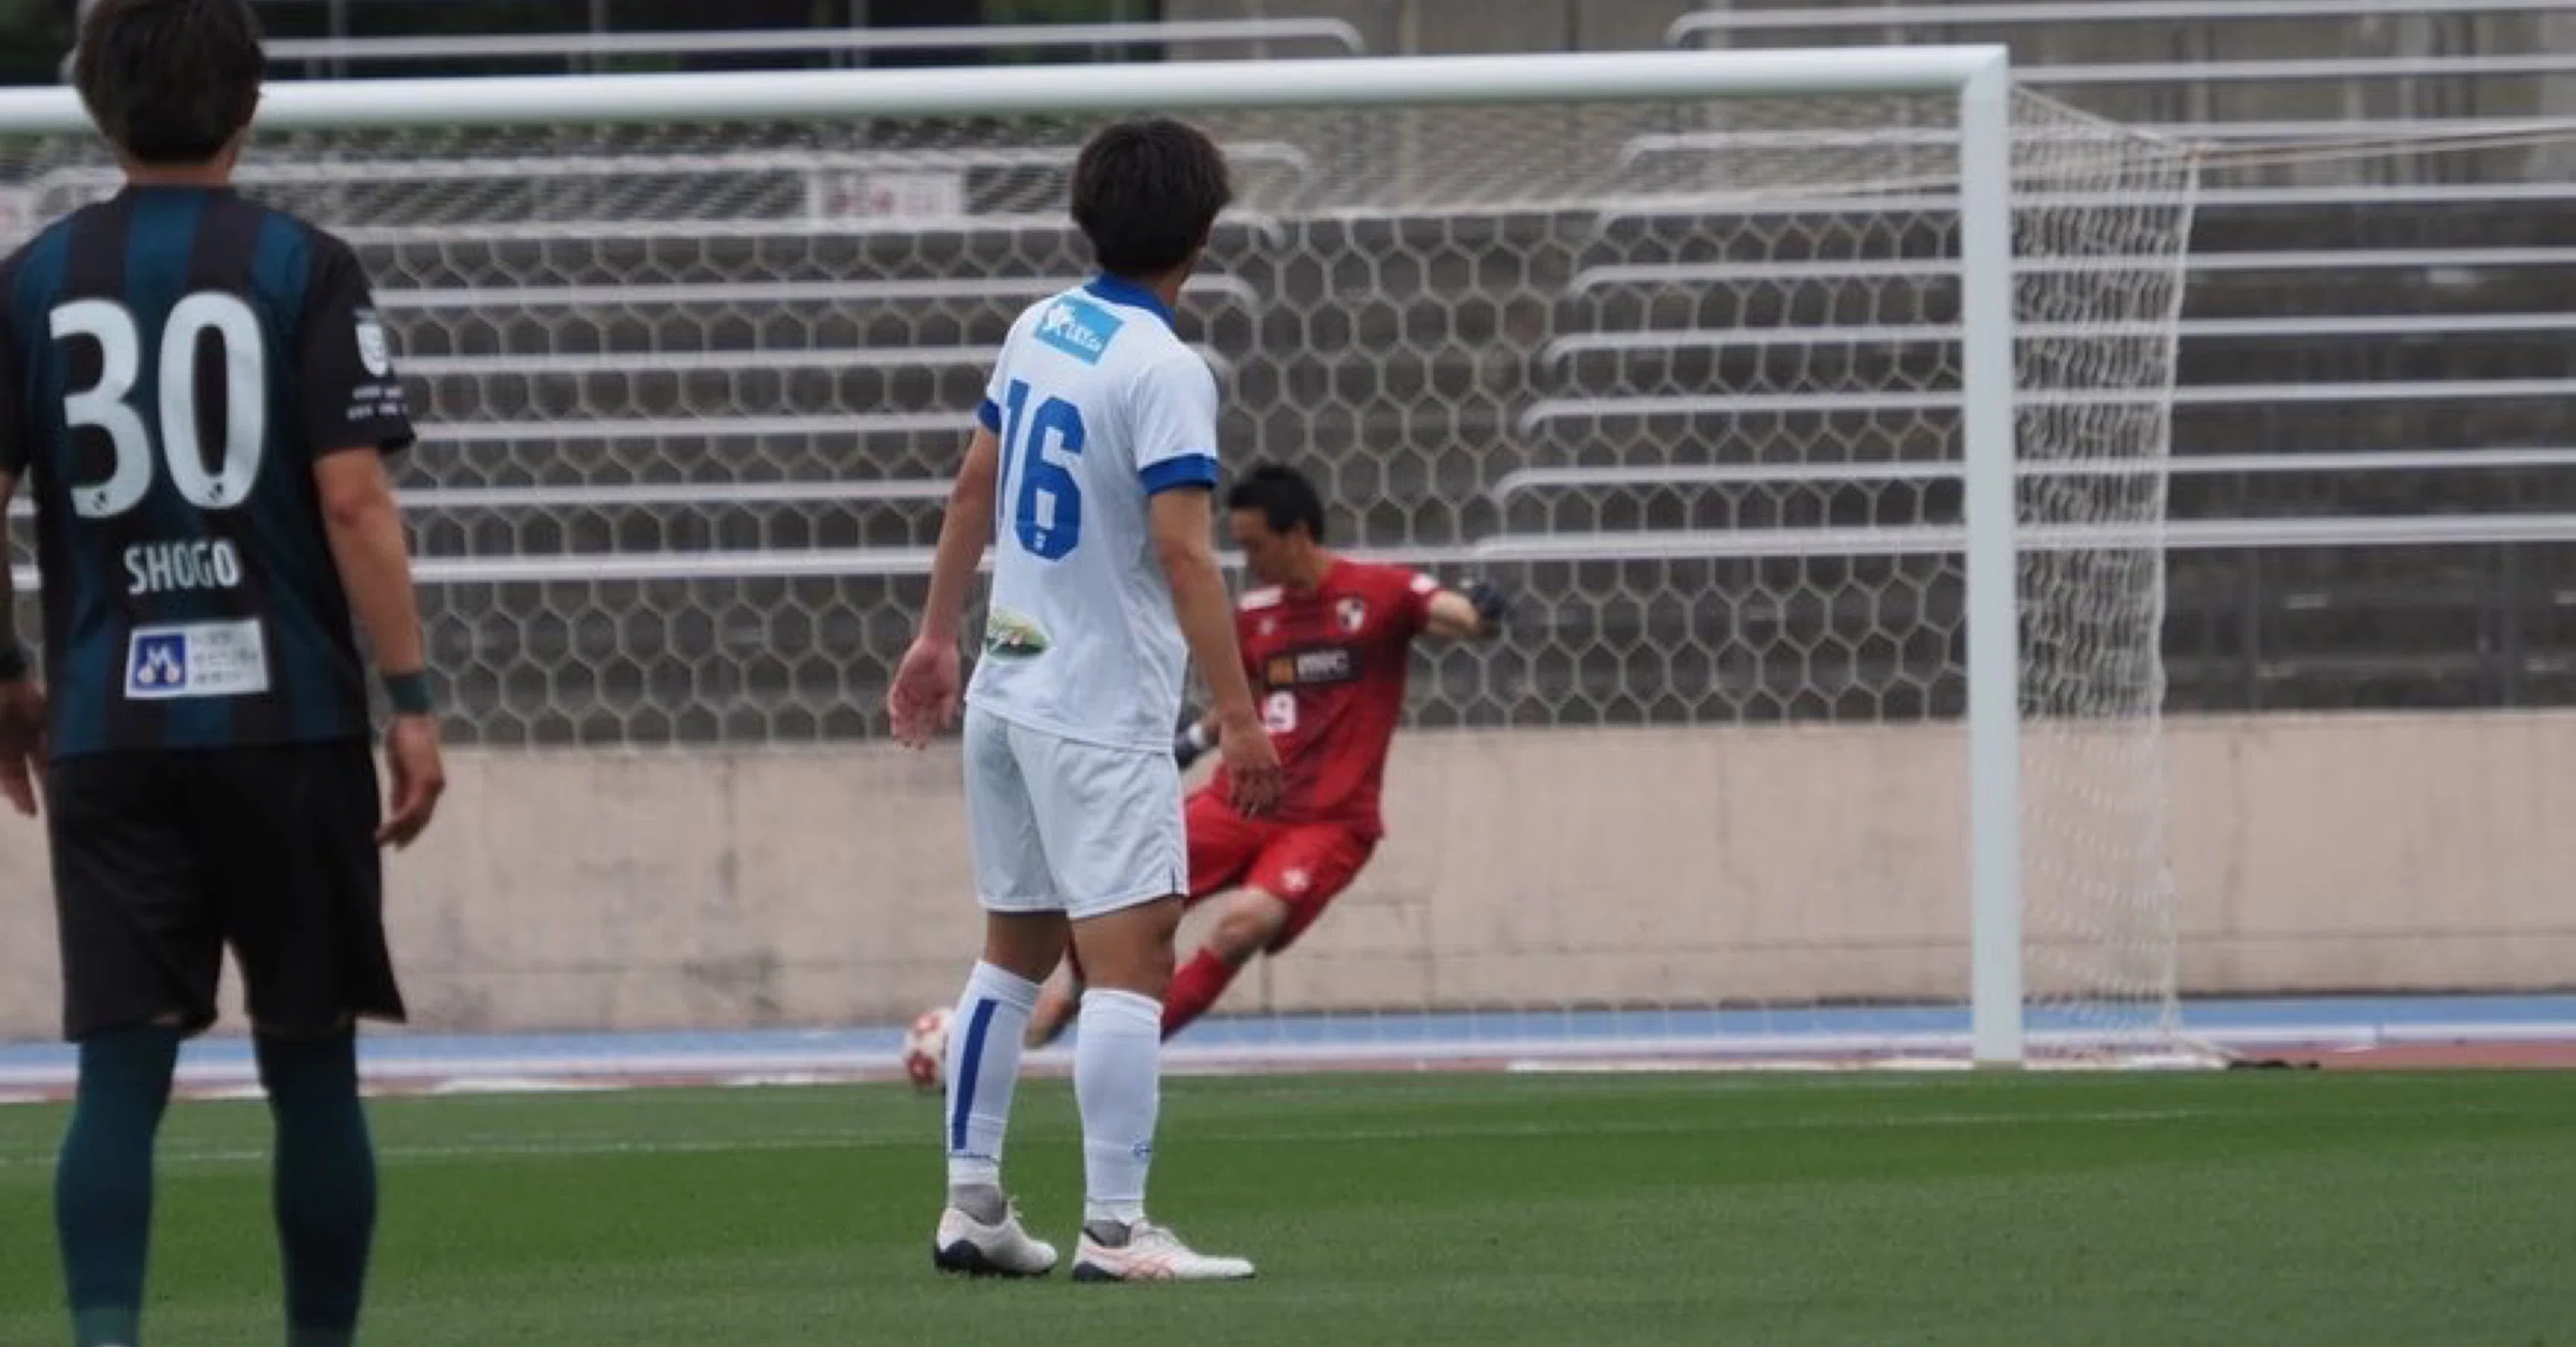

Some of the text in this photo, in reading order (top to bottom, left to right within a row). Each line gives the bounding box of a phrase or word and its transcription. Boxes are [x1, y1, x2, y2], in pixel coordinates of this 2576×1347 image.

[49, 292, 262, 518] 30
[999, 377, 1084, 561] 16
[123, 540, 241, 595] SHOGO
